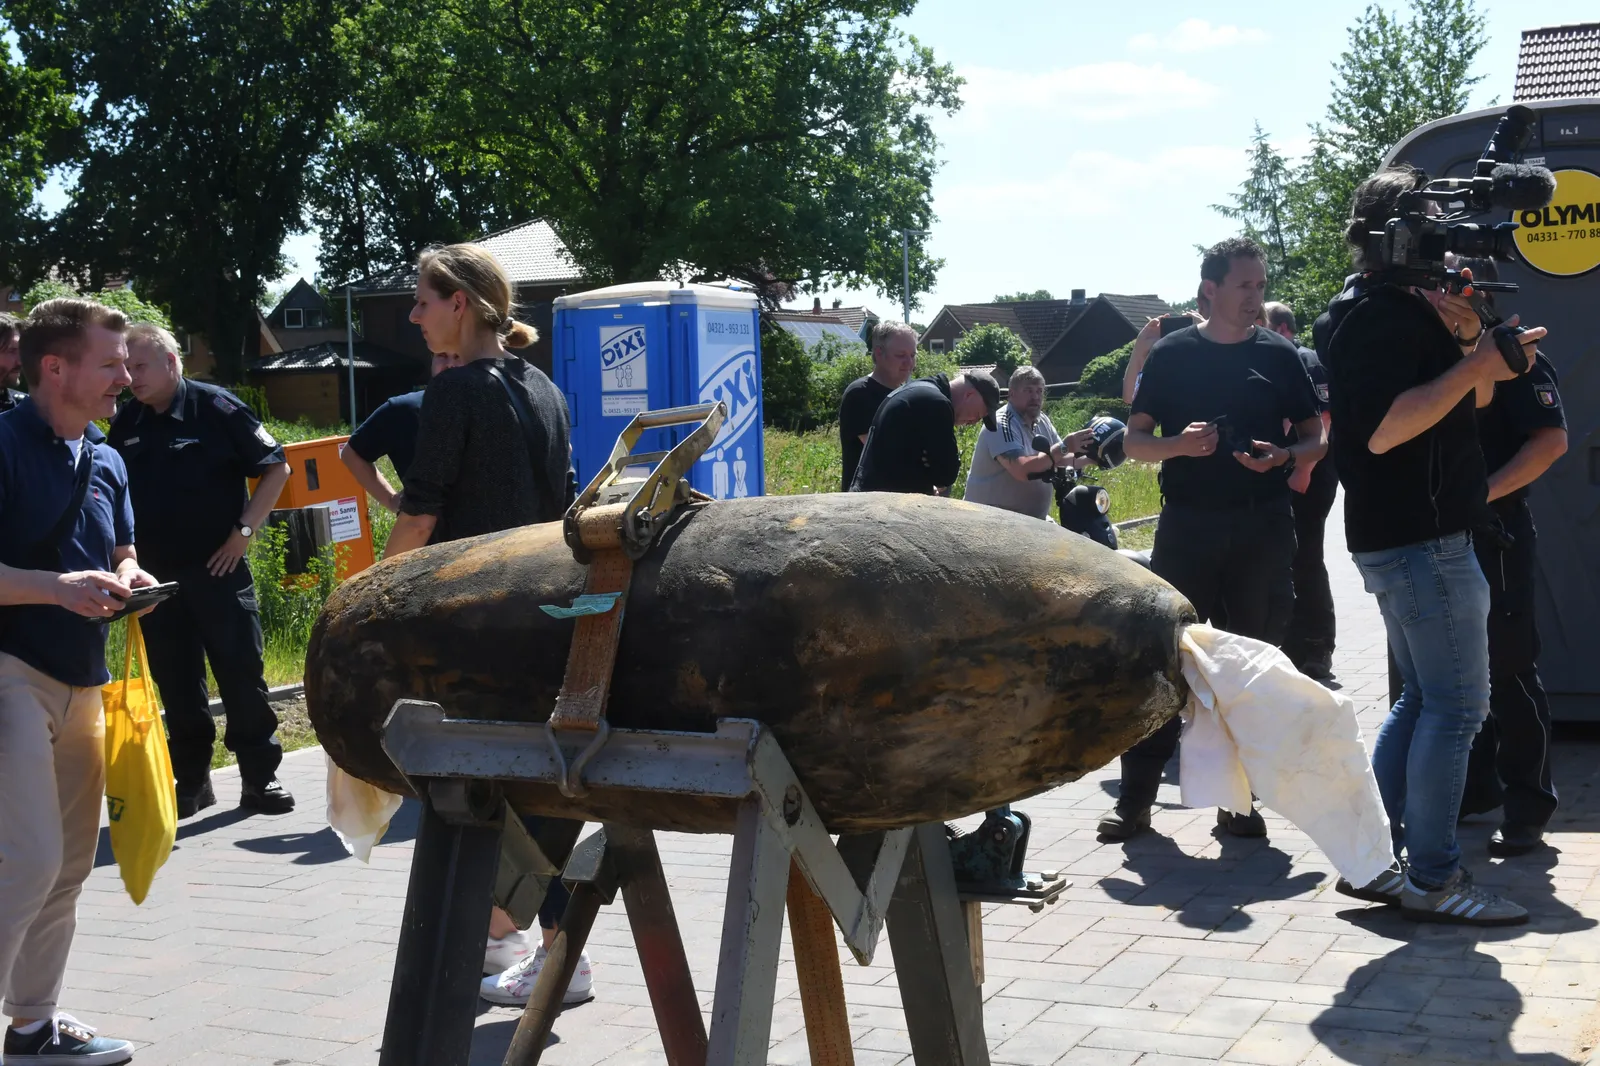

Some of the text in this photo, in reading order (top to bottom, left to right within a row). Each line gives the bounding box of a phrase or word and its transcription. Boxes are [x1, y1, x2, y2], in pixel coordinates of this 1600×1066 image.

[1520, 203, 1600, 228] OLYM
[1527, 230, 1558, 243] 04331
[1568, 229, 1586, 240] 770
[707, 322, 724, 334] 04321
[728, 323, 739, 335] 953
[740, 324, 750, 335] 131
[340, 506, 356, 514] Sanny
